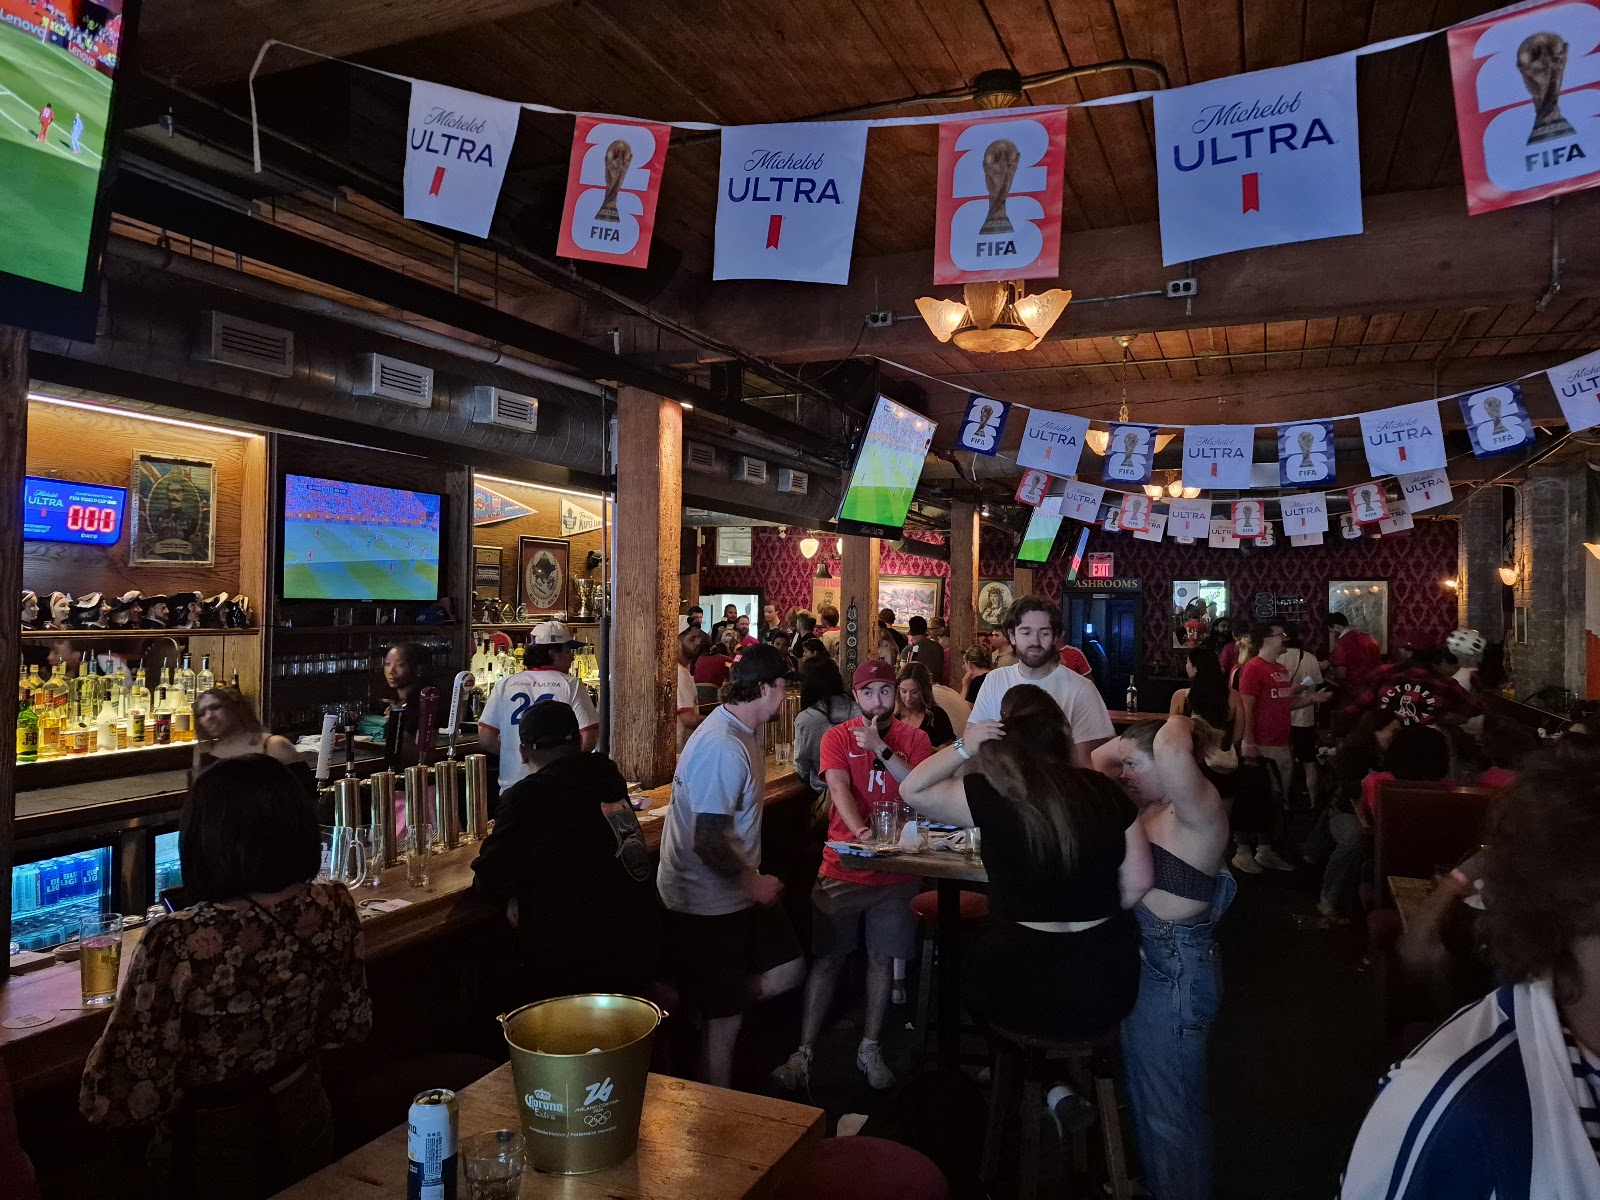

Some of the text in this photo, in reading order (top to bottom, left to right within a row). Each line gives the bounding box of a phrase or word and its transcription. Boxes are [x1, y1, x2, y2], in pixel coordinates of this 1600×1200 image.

[0, 8, 46, 38] Lenovo
[68, 42, 97, 67] Lenovo
[424, 107, 487, 134] Michelob
[1191, 91, 1302, 134] Michelob
[411, 127, 493, 167] ULTRA
[1173, 118, 1335, 172] ULTRA
[744, 149, 825, 171] Michelob
[1525, 143, 1586, 172] FIFA
[728, 177, 841, 204] ULTRA
[590, 226, 620, 242] FIFA
[976, 240, 1017, 257] FIFA
[1567, 366, 1600, 382] Miche
[1561, 375, 1600, 398] ULT
[970, 437, 985, 446] FIFA
[1028, 427, 1076, 447] ULTRA
[1369, 425, 1433, 446] ULTRA
[1492, 434, 1514, 445] FIFA
[1188, 447, 1244, 459] ULTRA
[1118, 468, 1135, 476] FIFA
[1298, 469, 1317, 477] FIFA
[1405, 476, 1444, 494] ULTRA
[28, 496, 64, 507] ULTRA
[1066, 492, 1097, 506] ULTRA
[67, 504, 116, 533] 000
[1172, 511, 1206, 520] ULTRA
[1285, 506, 1322, 517] ULTRA
[1092, 563, 1110, 577] EXIT
[1074, 579, 1138, 588] ASHROOMS
[61, 878, 77, 886] LIG
[63, 871, 77, 880] BU
[84, 874, 98, 883] LIG
[46, 884, 60, 893] LIG
[524, 1093, 564, 1112] Corona
[598, 1099, 620, 1108] CORTINA
[534, 1108, 556, 1120] Extra
